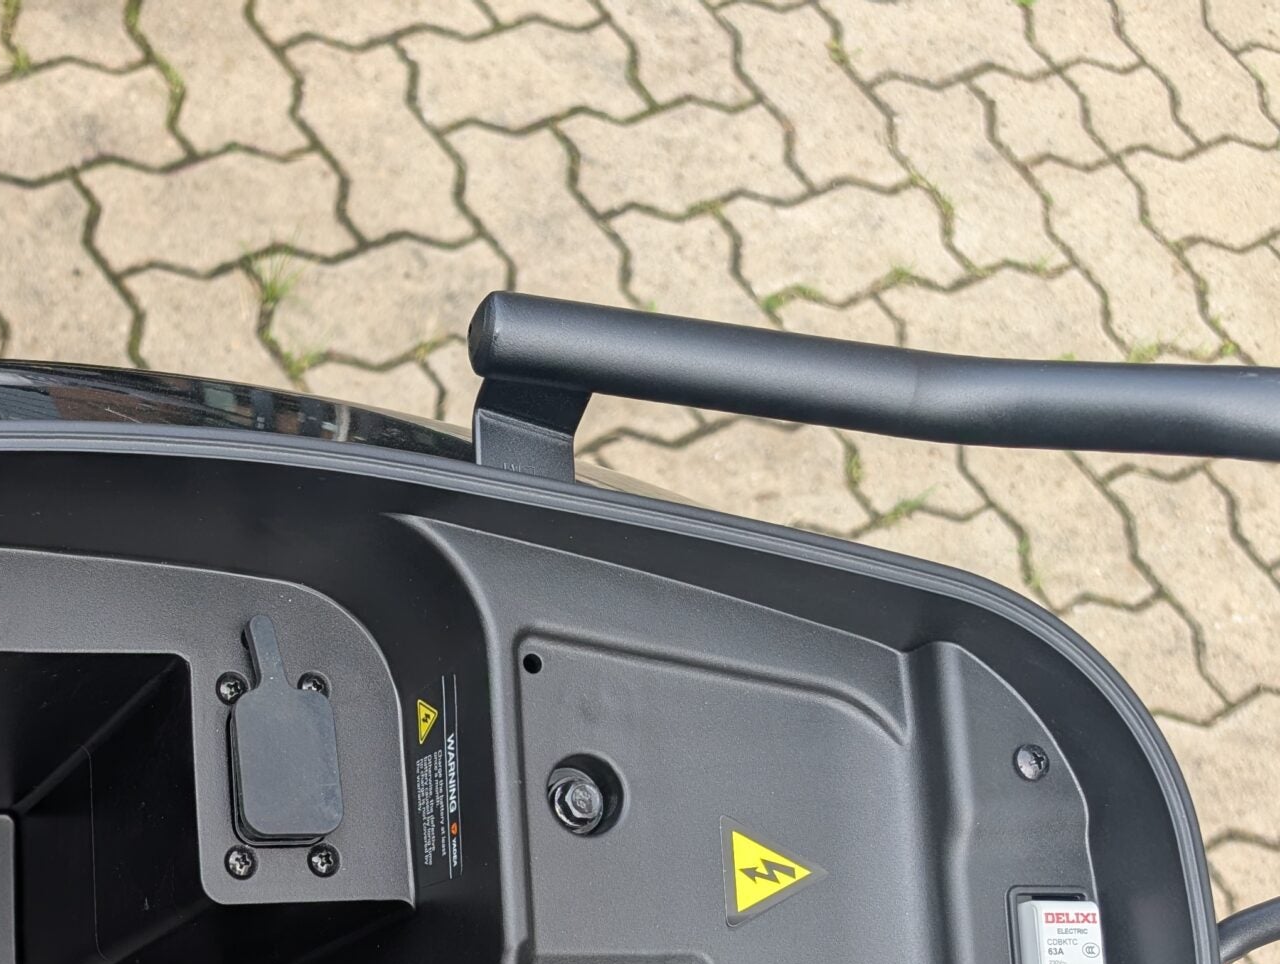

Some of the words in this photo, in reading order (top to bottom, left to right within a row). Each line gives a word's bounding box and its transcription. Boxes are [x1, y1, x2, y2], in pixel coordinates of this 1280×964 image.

[447, 733, 457, 813] WARNING
[1044, 912, 1097, 924] DELIXI
[1048, 947, 1064, 956] 63A
